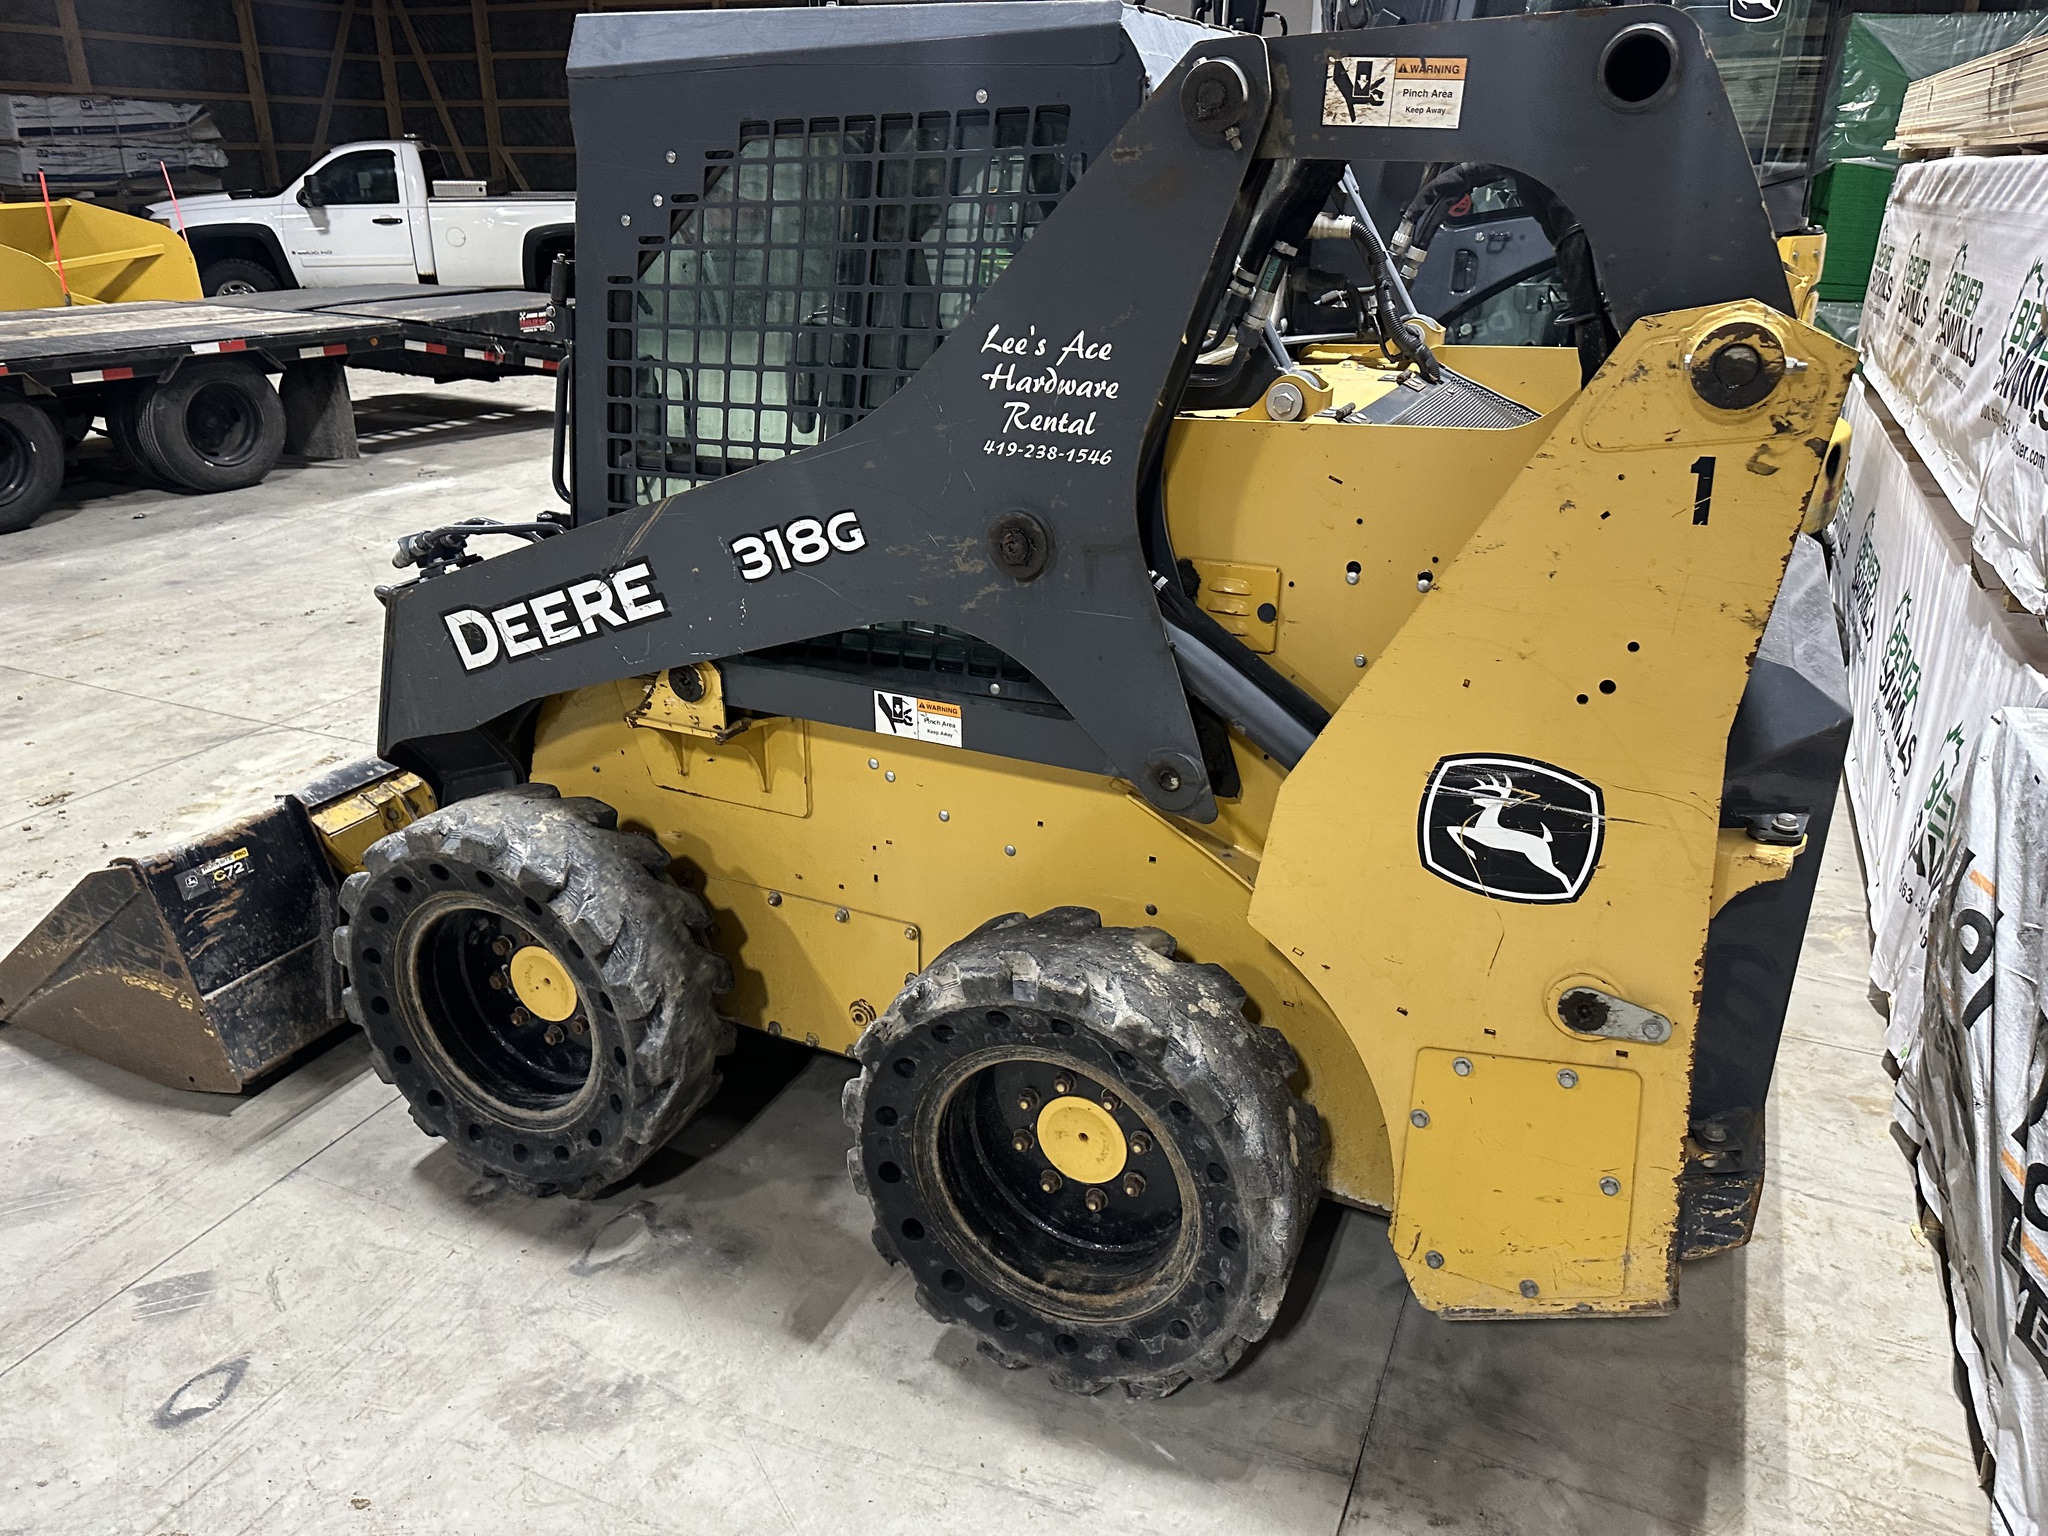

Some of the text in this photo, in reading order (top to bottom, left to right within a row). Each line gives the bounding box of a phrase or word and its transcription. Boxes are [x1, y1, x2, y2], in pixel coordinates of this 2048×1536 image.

[1410, 64, 1460, 74] WARNING
[1402, 88, 1453, 98] Pinch Area
[1426, 107, 1446, 116] Away
[1945, 271, 1984, 320] BIEWER
[981, 323, 1112, 366] Lee's Ace
[1935, 307, 1984, 368] SAWMILLS
[981, 363, 1119, 399] Hardware
[1002, 401, 1097, 435] Rental
[983, 439, 1113, 465] 419-238-1546
[1690, 456, 1716, 525] 1
[731, 511, 866, 580] 318G
[443, 562, 665, 671] DEERE
[926, 704, 958, 715] WARNING
[942, 720, 956, 729] Area
[940, 731, 953, 739] Away
[213, 861, 245, 881] C72
